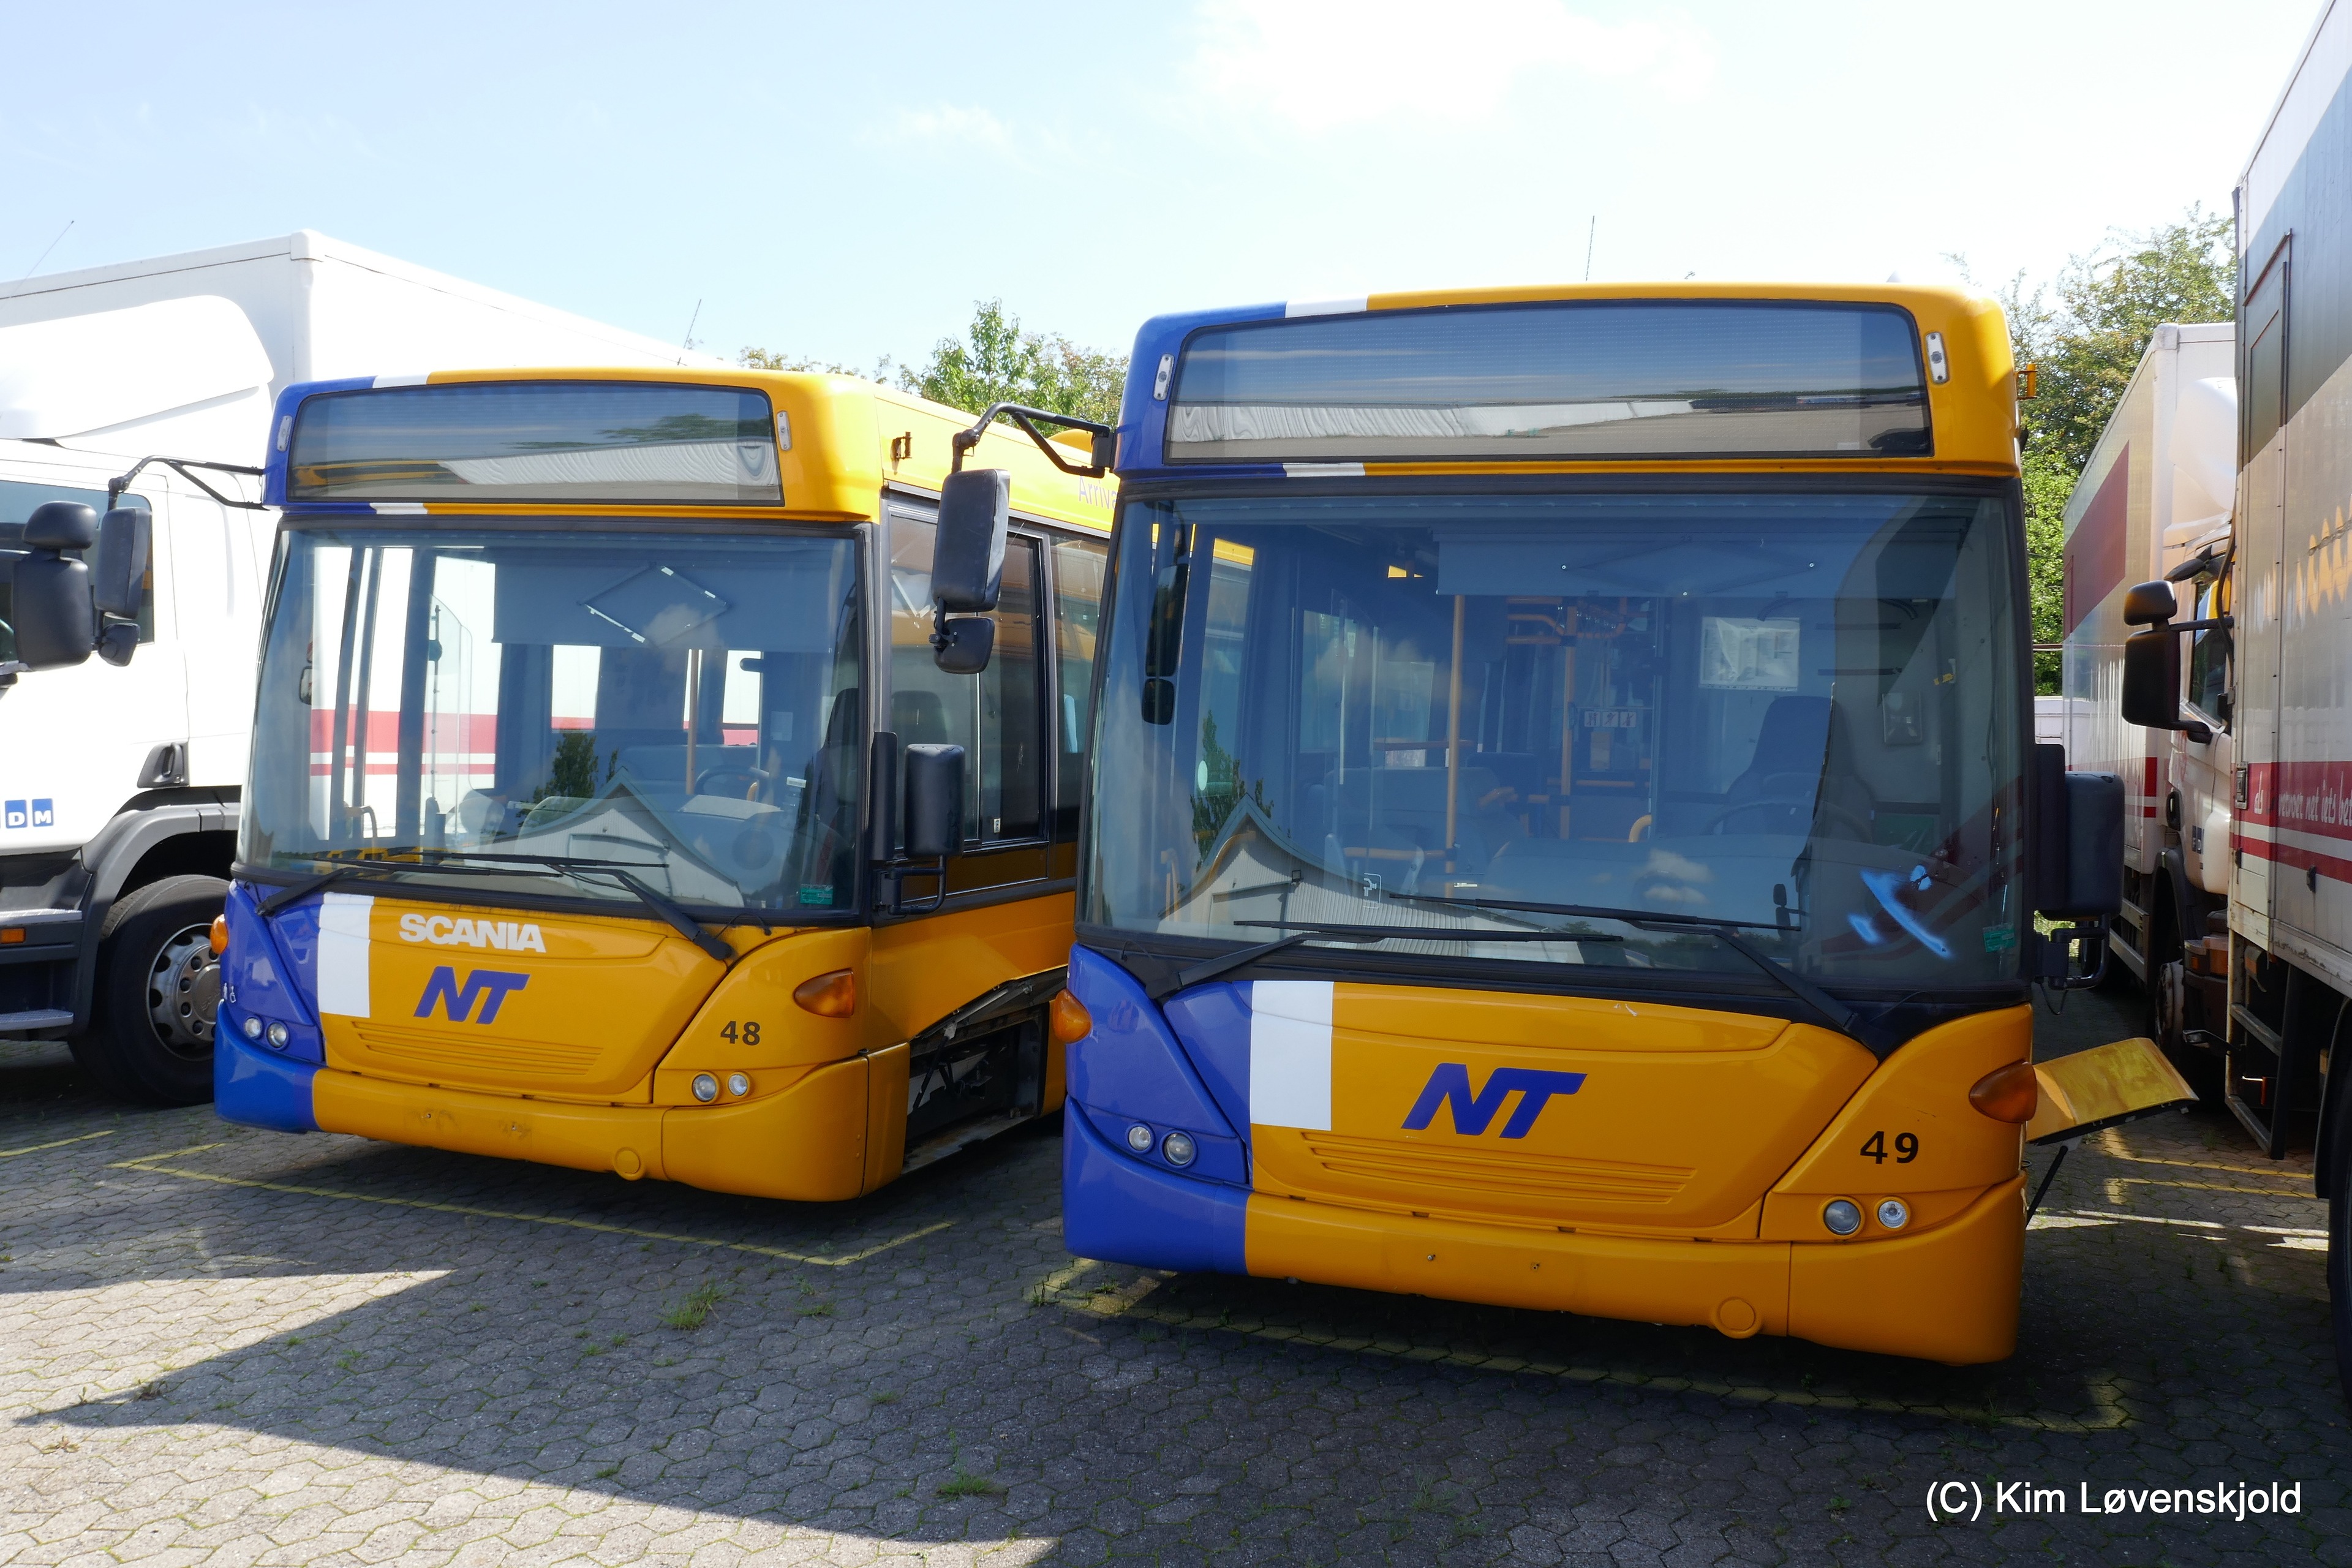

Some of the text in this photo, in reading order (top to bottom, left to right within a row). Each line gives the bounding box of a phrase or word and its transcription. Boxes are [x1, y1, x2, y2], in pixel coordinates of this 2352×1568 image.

[399, 913, 546, 953] SCANIA
[415, 966, 530, 1024] NT
[720, 1021, 761, 1046] 48
[1401, 1063, 1588, 1139] NT
[1860, 1131, 1920, 1165] 49
